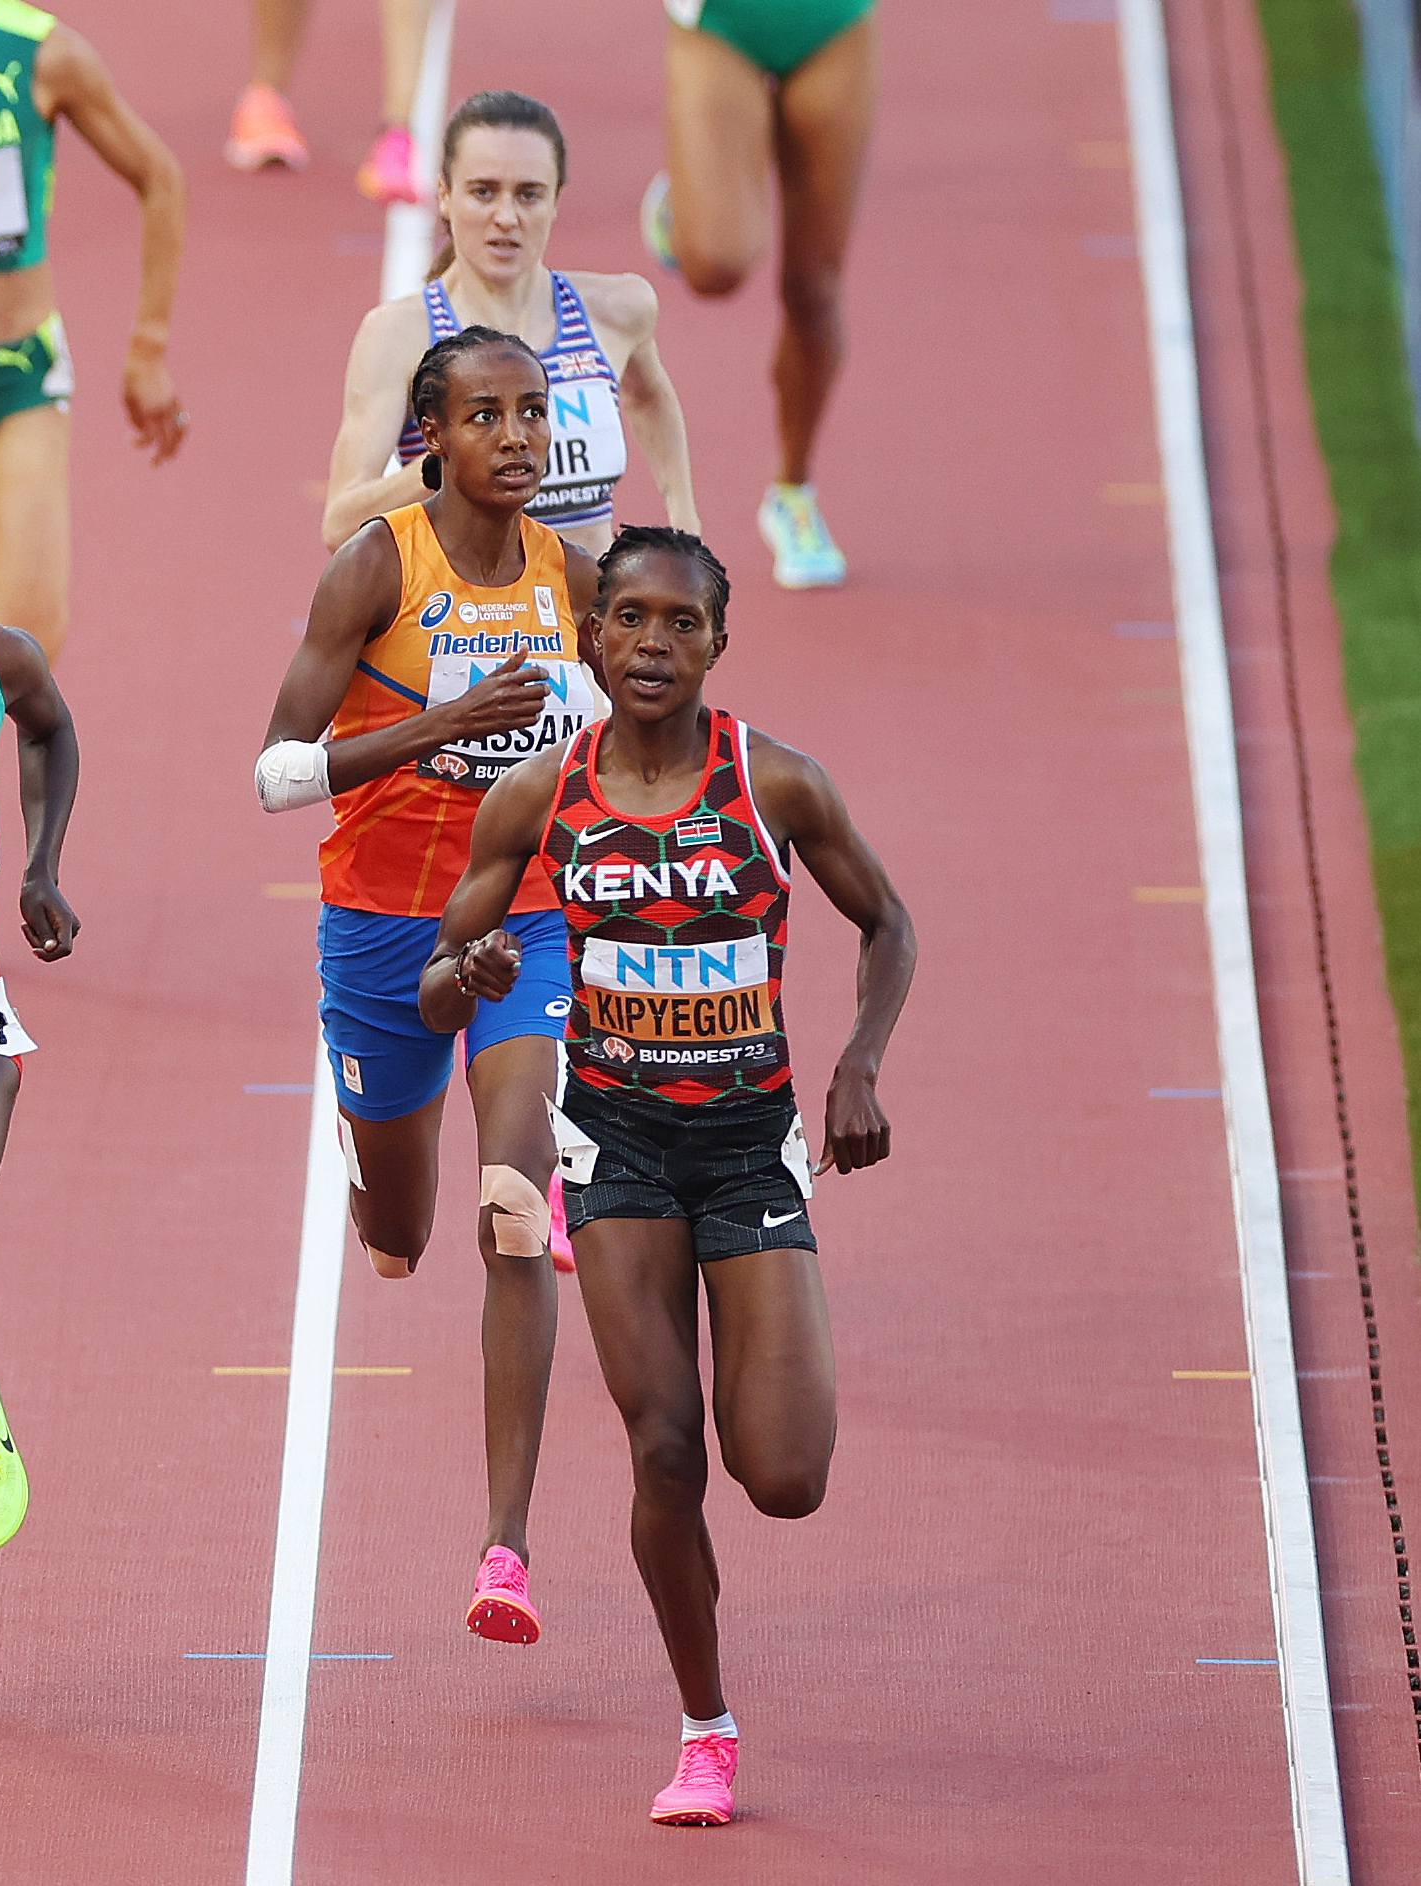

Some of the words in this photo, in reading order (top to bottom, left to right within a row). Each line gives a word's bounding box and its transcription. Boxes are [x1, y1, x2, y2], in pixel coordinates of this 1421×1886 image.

[522, 484, 601, 509] DAPEST
[564, 859, 739, 902] KENYA
[616, 944, 737, 989] NTN
[595, 990, 762, 1037] KIPYEGON
[639, 1047, 743, 1064] BUDAPEST
[744, 1043, 766, 1057] 23
